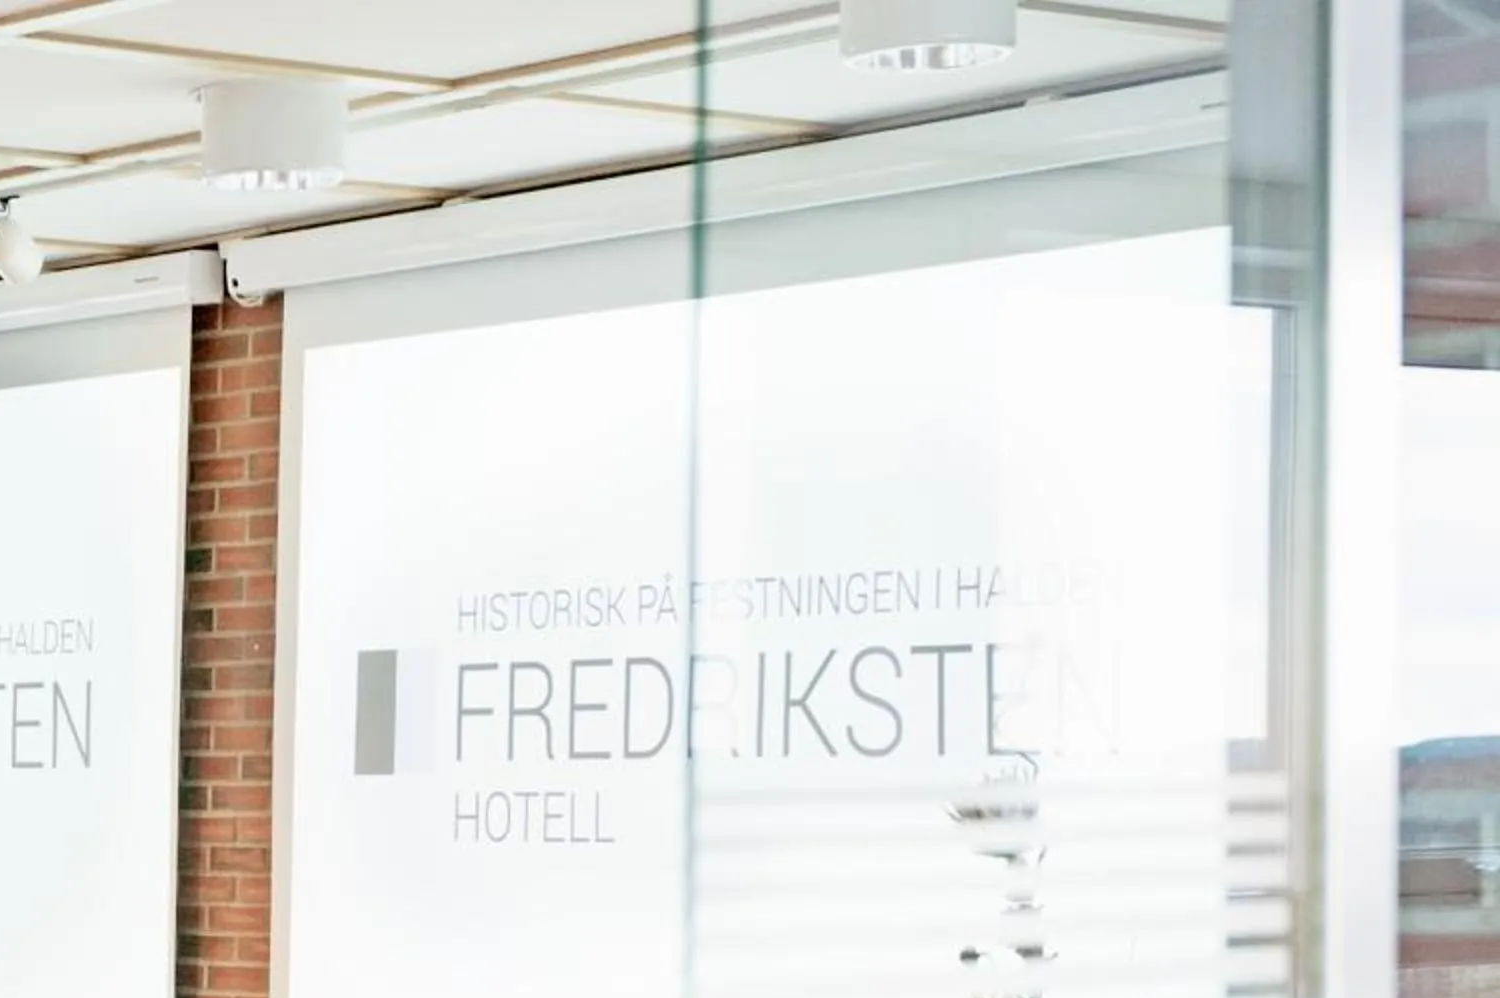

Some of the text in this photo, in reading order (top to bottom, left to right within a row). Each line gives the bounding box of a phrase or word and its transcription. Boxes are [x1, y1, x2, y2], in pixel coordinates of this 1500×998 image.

[457, 585, 627, 633] HISTORISK
[638, 571, 678, 625] PÅ
[689, 569, 921, 624] FESTNINGEN
[934, 569, 942, 612] I
[454, 642, 1123, 763] FREDRIKSTEN
[453, 790, 617, 845] HOTELL
